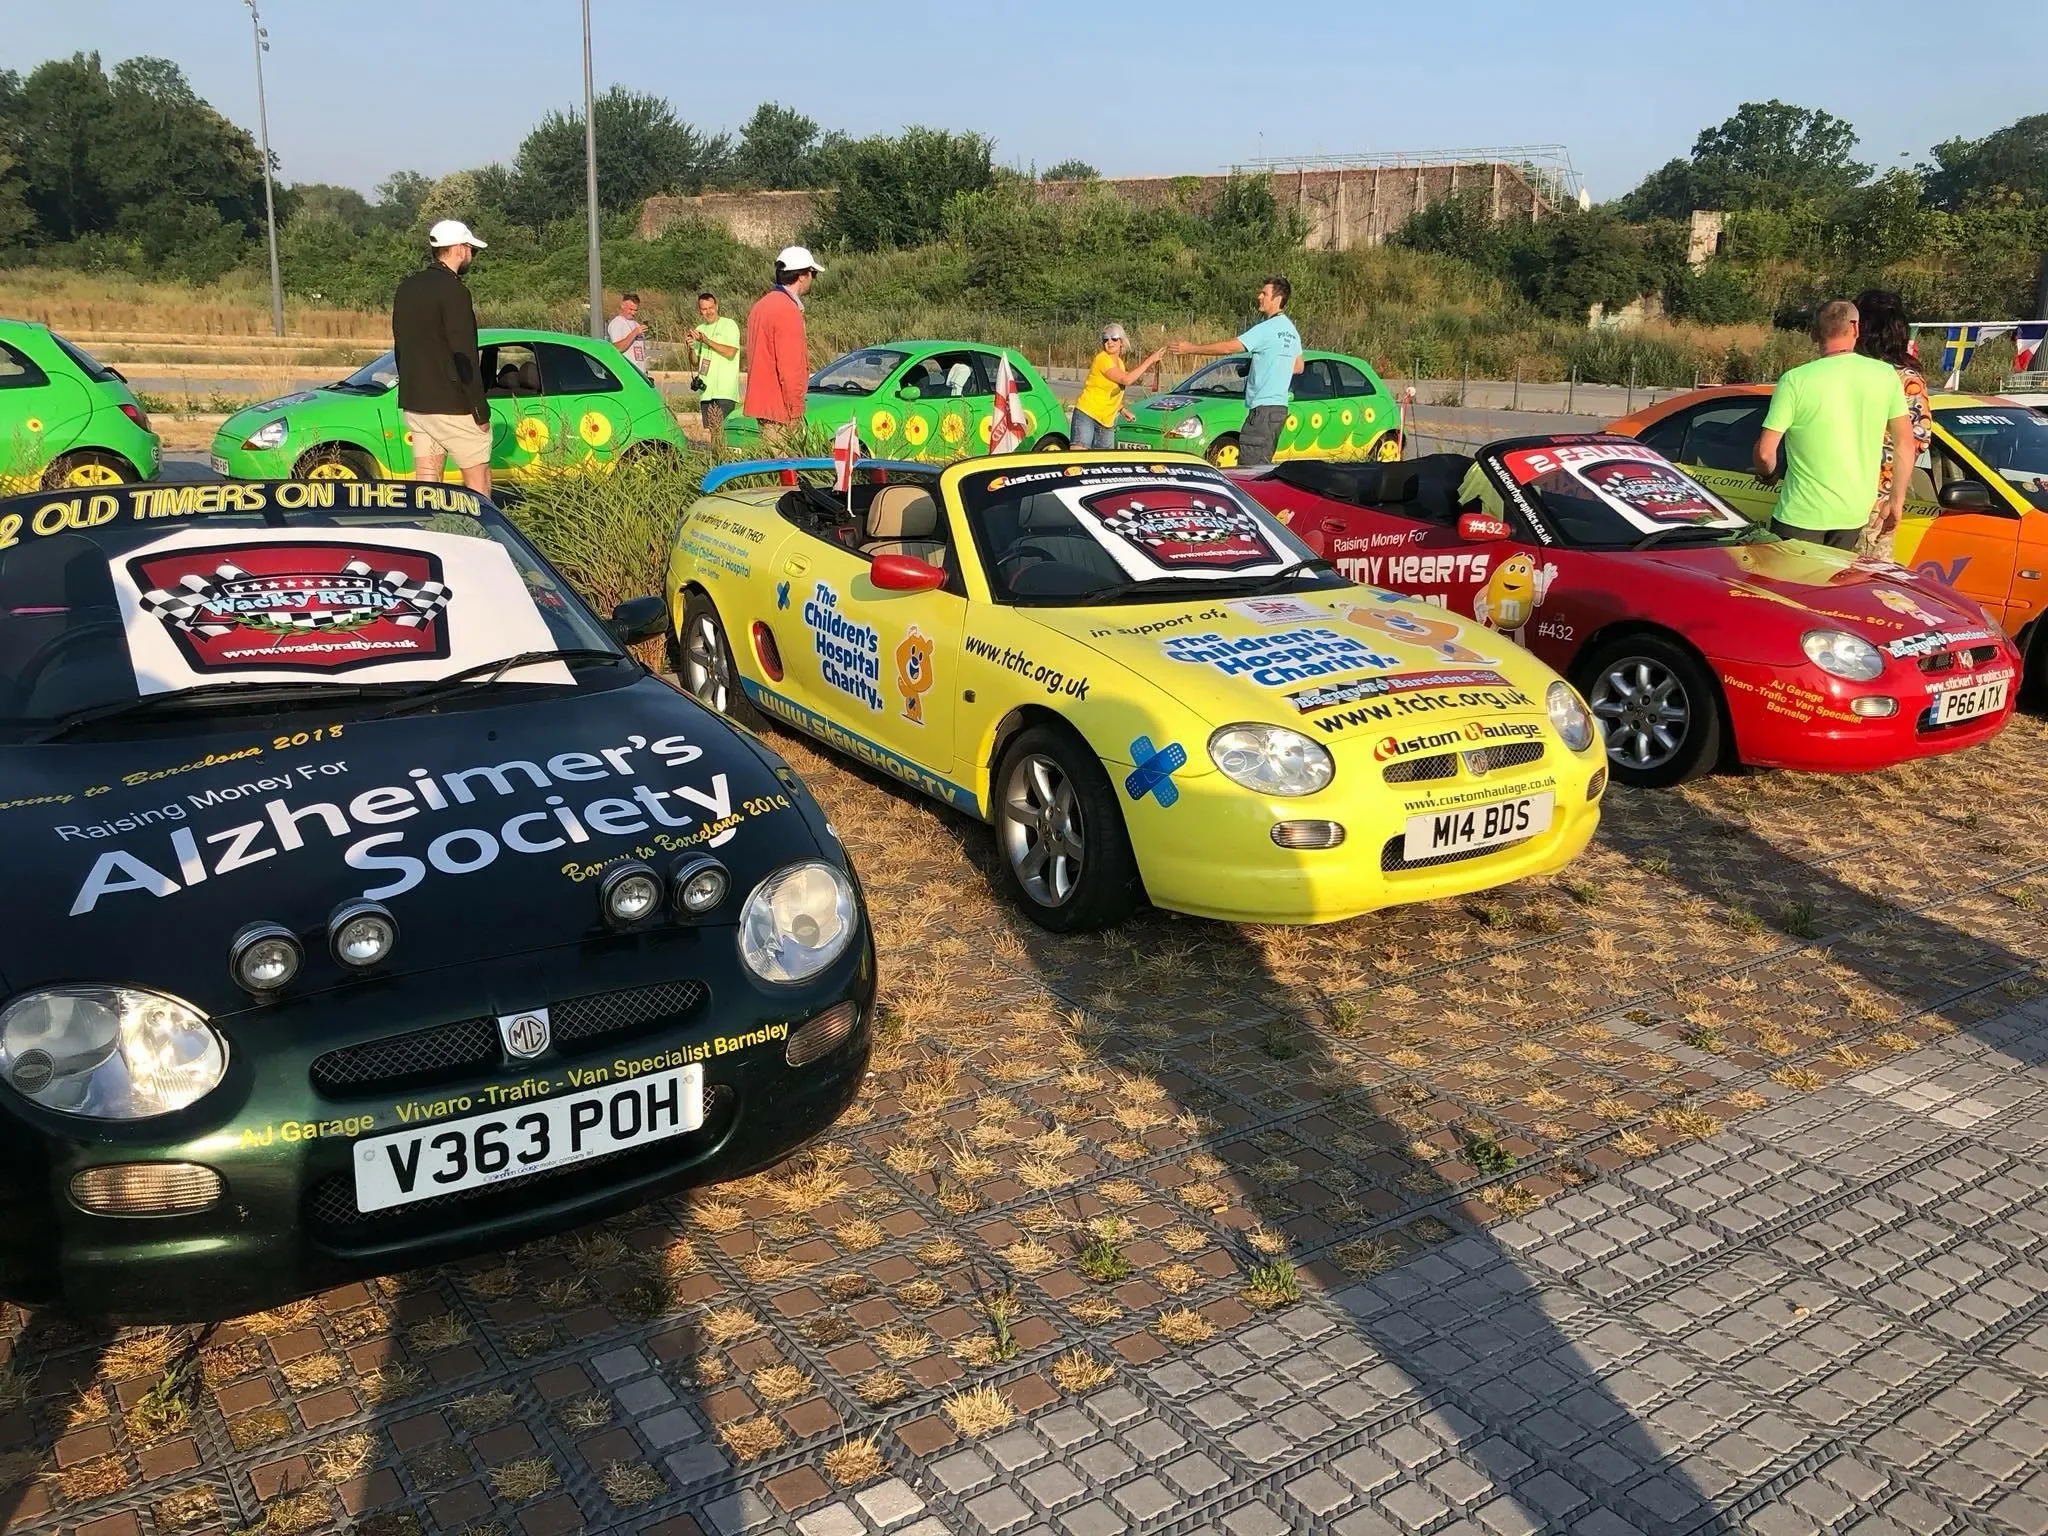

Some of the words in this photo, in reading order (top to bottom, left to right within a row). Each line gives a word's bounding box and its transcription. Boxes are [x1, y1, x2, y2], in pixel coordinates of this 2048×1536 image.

[1135, 465, 1148, 474] &
[32, 495, 119, 536] OLD
[129, 483, 267, 520] TIMERS
[276, 482, 335, 509] ON
[342, 482, 407, 508] THE
[415, 486, 481, 516] RUN
[731, 522, 747, 536] TEAM
[1333, 537, 1369, 553] Raising
[1371, 532, 1406, 547] Money
[1408, 529, 1428, 543] For
[1468, 519, 1504, 535] #432
[201, 591, 314, 616] Wacky
[316, 590, 402, 611] Rally
[816, 583, 837, 608] The
[804, 602, 878, 653] Children's
[1090, 628, 1112, 638] in
[1117, 614, 1199, 637] support
[1163, 633, 1222, 649] The
[1538, 621, 1574, 641] #432
[222, 639, 419, 659] www.wackyrally.co.uk
[816, 632, 879, 681] Hospital
[1167, 628, 1339, 662] Children's
[1214, 638, 1368, 675] Hospital
[822, 660, 877, 710] Charity
[965, 635, 1090, 701] www.tchc.org.uk
[1252, 653, 1388, 686] Charity
[1299, 685, 1361, 709] Barmy
[1390, 673, 1473, 690] Barcelona
[1723, 674, 1754, 692] Vivaro
[1794, 698, 1815, 711] Van
[1815, 705, 1863, 724] Specialist
[1769, 678, 1786, 691] AJ
[1786, 684, 1824, 703] Garage
[1945, 691, 1977, 718] P66
[1977, 684, 2003, 712] ATX
[1766, 701, 1812, 723] Barnsley
[121, 746, 264, 787] Barcelona
[272, 724, 345, 751] 2018
[53, 803, 188, 842] Raising
[186, 770, 293, 810] Money
[295, 759, 349, 781] For
[1404, 776, 1557, 811] www.customhaulage.co.uk
[69, 735, 704, 917] Alzheimer's
[1483, 799, 1531, 840] BDS
[345, 773, 738, 902] Society
[561, 853, 633, 883] Bar
[655, 811, 745, 852] Barcelona
[510, 1020, 546, 1048] MG
[239, 1124, 273, 1149] AJ
[281, 1113, 375, 1142] Garage
[396, 1093, 472, 1123] Vivaro
[567, 1066, 609, 1088] Van
[613, 1041, 712, 1080] Specialist
[714, 1022, 789, 1056] Barnsley
[387, 1112, 551, 1194] V363
[570, 1077, 679, 1153] POH
